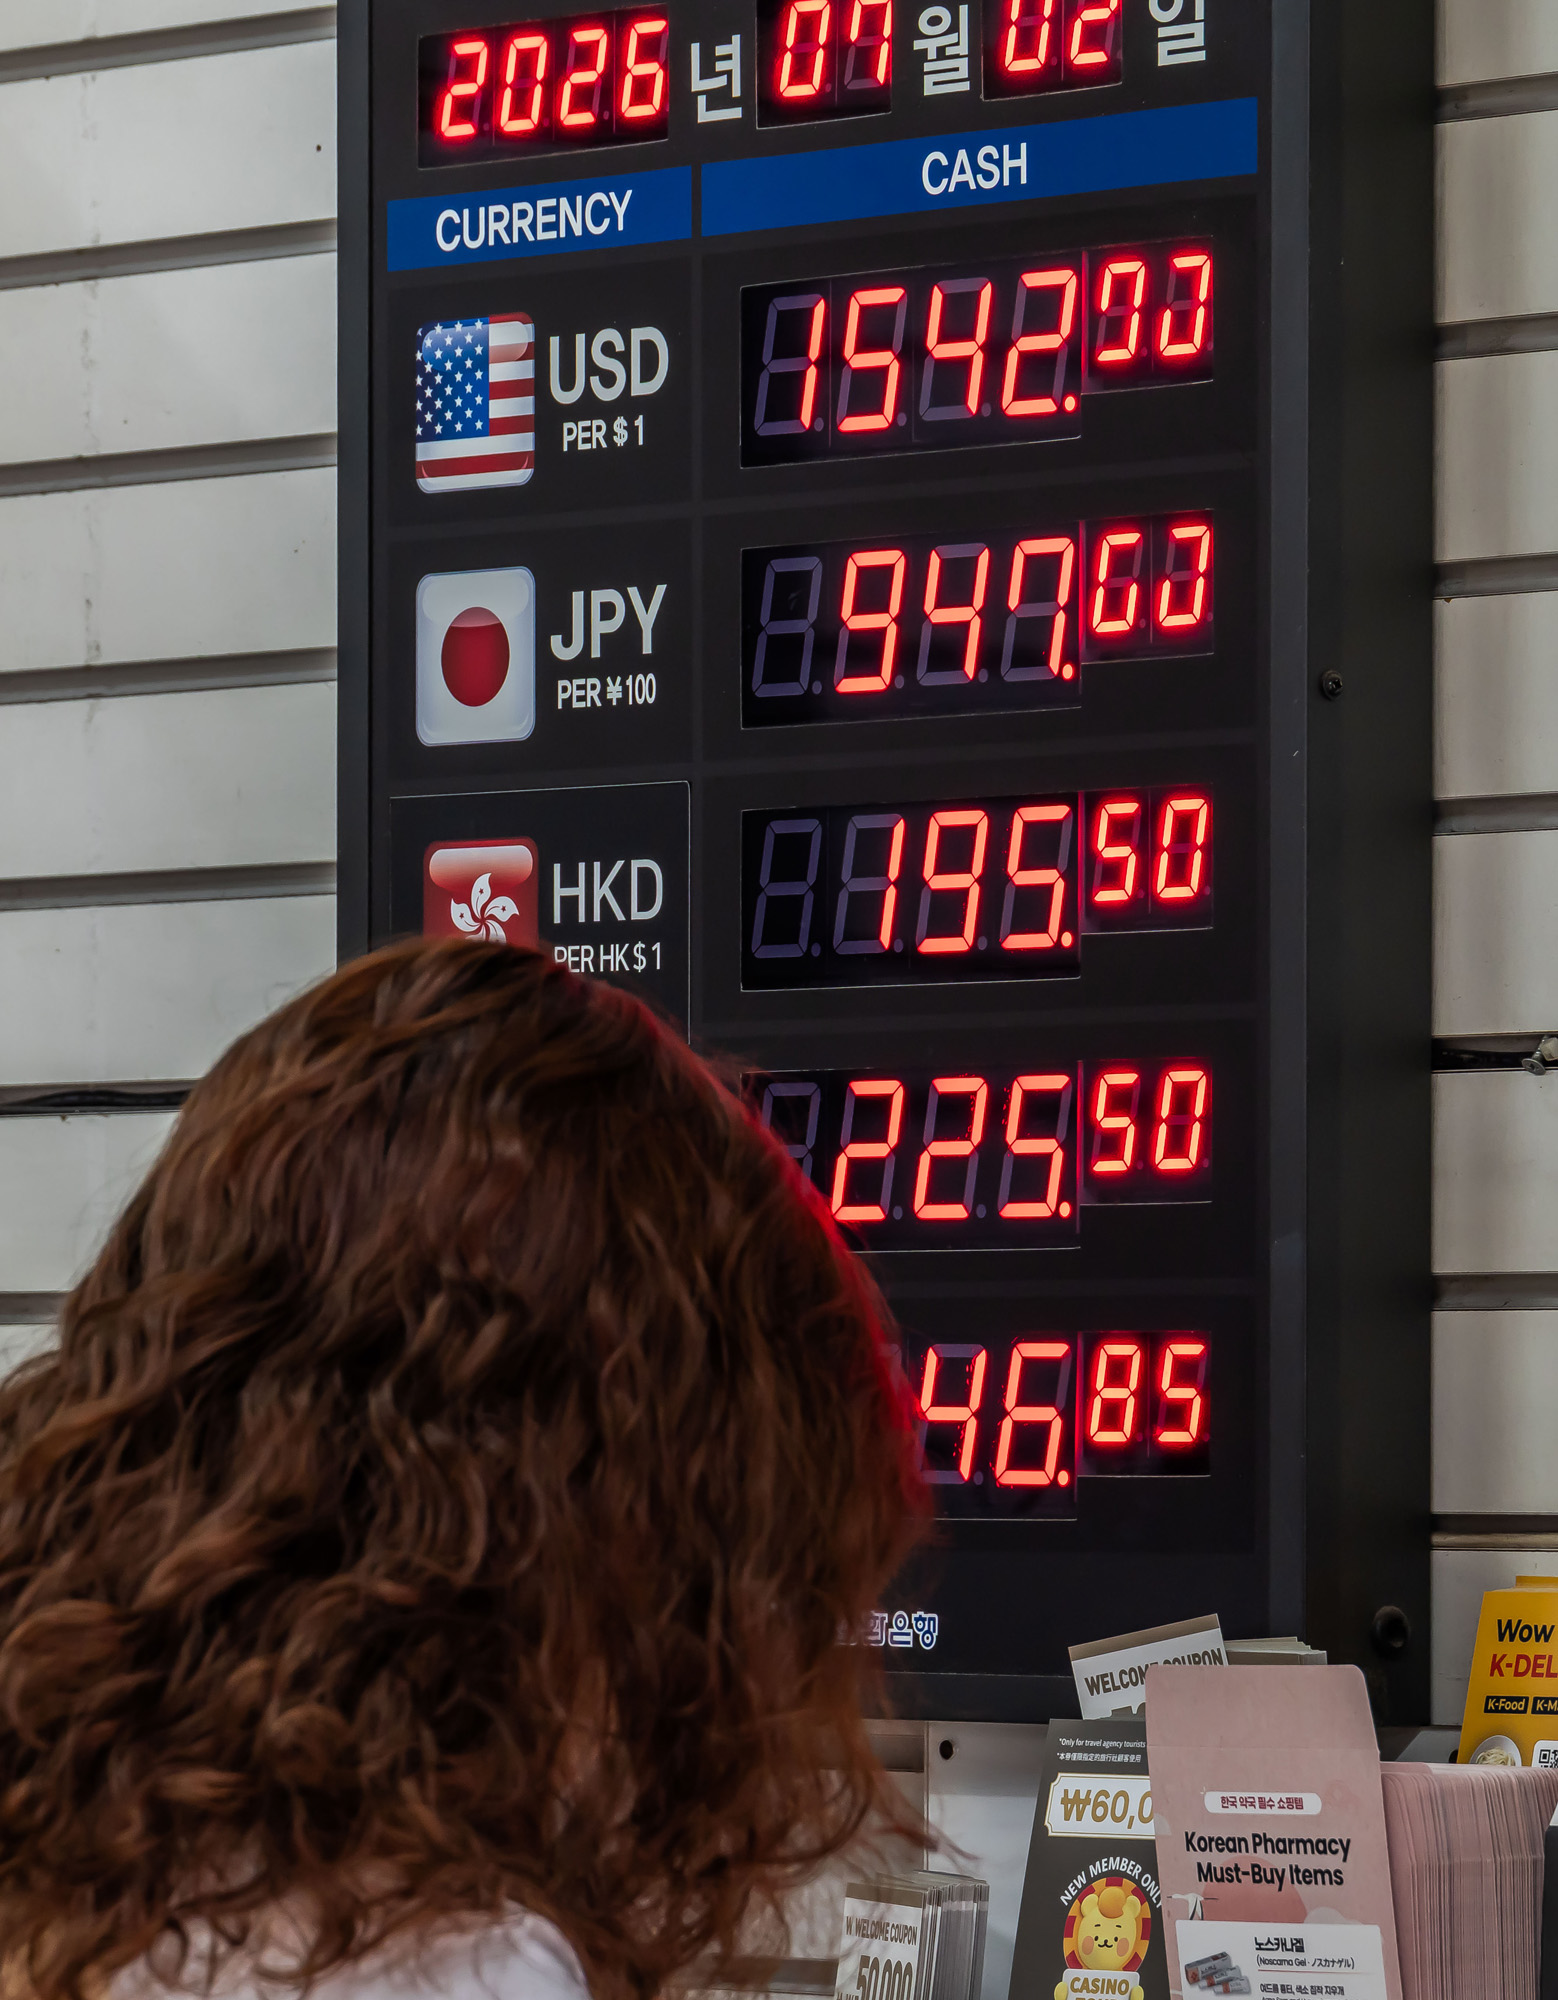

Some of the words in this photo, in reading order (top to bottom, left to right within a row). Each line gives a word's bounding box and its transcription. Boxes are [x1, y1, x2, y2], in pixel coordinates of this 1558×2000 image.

[440, 20, 667, 138] 2026
[691, 35, 742, 123] 년
[779, 0, 892, 98] 07
[914, 5, 970, 95] 월
[1004, 0, 1119, 72] 02
[1148, 0, 1206, 66] 일
[922, 142, 1028, 195] CASH
[435, 189, 633, 252] CURRENCY
[549, 326, 669, 405] USD
[563, 419, 608, 452] PER
[550, 584, 668, 661] JPY
[557, 679, 602, 709] PER
[880, 798, 1208, 953] 195.50
[553, 859, 663, 924] HKD
[554, 945, 595, 973] PER
[1497, 1618, 1555, 1643] Wow
[1084, 1662, 1158, 1697] WELCOM
[1489, 1653, 1558, 1678] K-DEL
[1487, 1698, 1526, 1711] K-Food
[1076, 1738, 1084, 1746] for
[1085, 1738, 1102, 1747] travel
[1102, 1740, 1123, 1749] agency
[1124, 1740, 1146, 1748] tourists
[1221, 1796, 1238, 1809] 한국
[1239, 1796, 1256, 1809] 약국
[1257, 1796, 1275, 1810] 필수
[1277, 1796, 1304, 1810] 쇼핑템
[1184, 1831, 1249, 1854] Korean
[1251, 1832, 1351, 1863] Pharmacy
[1060, 1871, 1087, 1906] NEW
[1089, 1856, 1142, 1880] MEMBER
[1196, 1861, 1286, 1892] Must-Buy
[1289, 1864, 1345, 1886] Items
[855, 1917, 890, 1942] WELCOME
[890, 1922, 918, 1946] COUPON
[1255, 1936, 1305, 1953] 노스카나겔
[1294, 1958, 1307, 1967] Gel
[1070, 1976, 1130, 1996] CASINO
